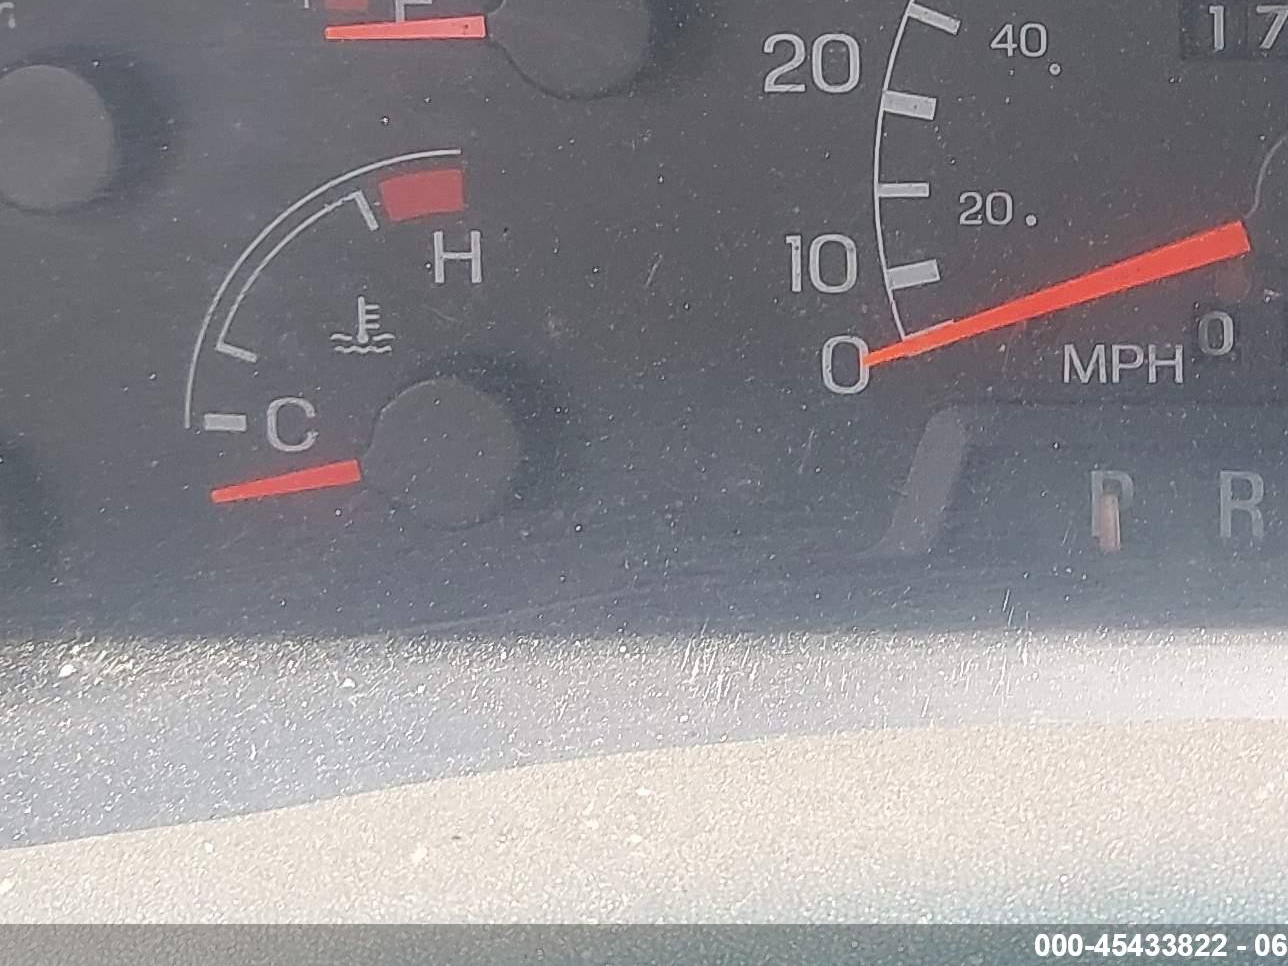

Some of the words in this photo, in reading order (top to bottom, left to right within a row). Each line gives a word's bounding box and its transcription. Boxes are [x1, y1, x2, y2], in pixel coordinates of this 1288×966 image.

[762, 34, 861, 94] 20
[990, 23, 1049, 59] 40
[958, 192, 1014, 226] 20
[433, 231, 482, 283] H
[785, 234, 858, 294] 10
[821, 336, 870, 395] 0
[1062, 343, 1185, 384] MPH
[266, 397, 317, 453] C
[1219, 470, 1266, 538] R
